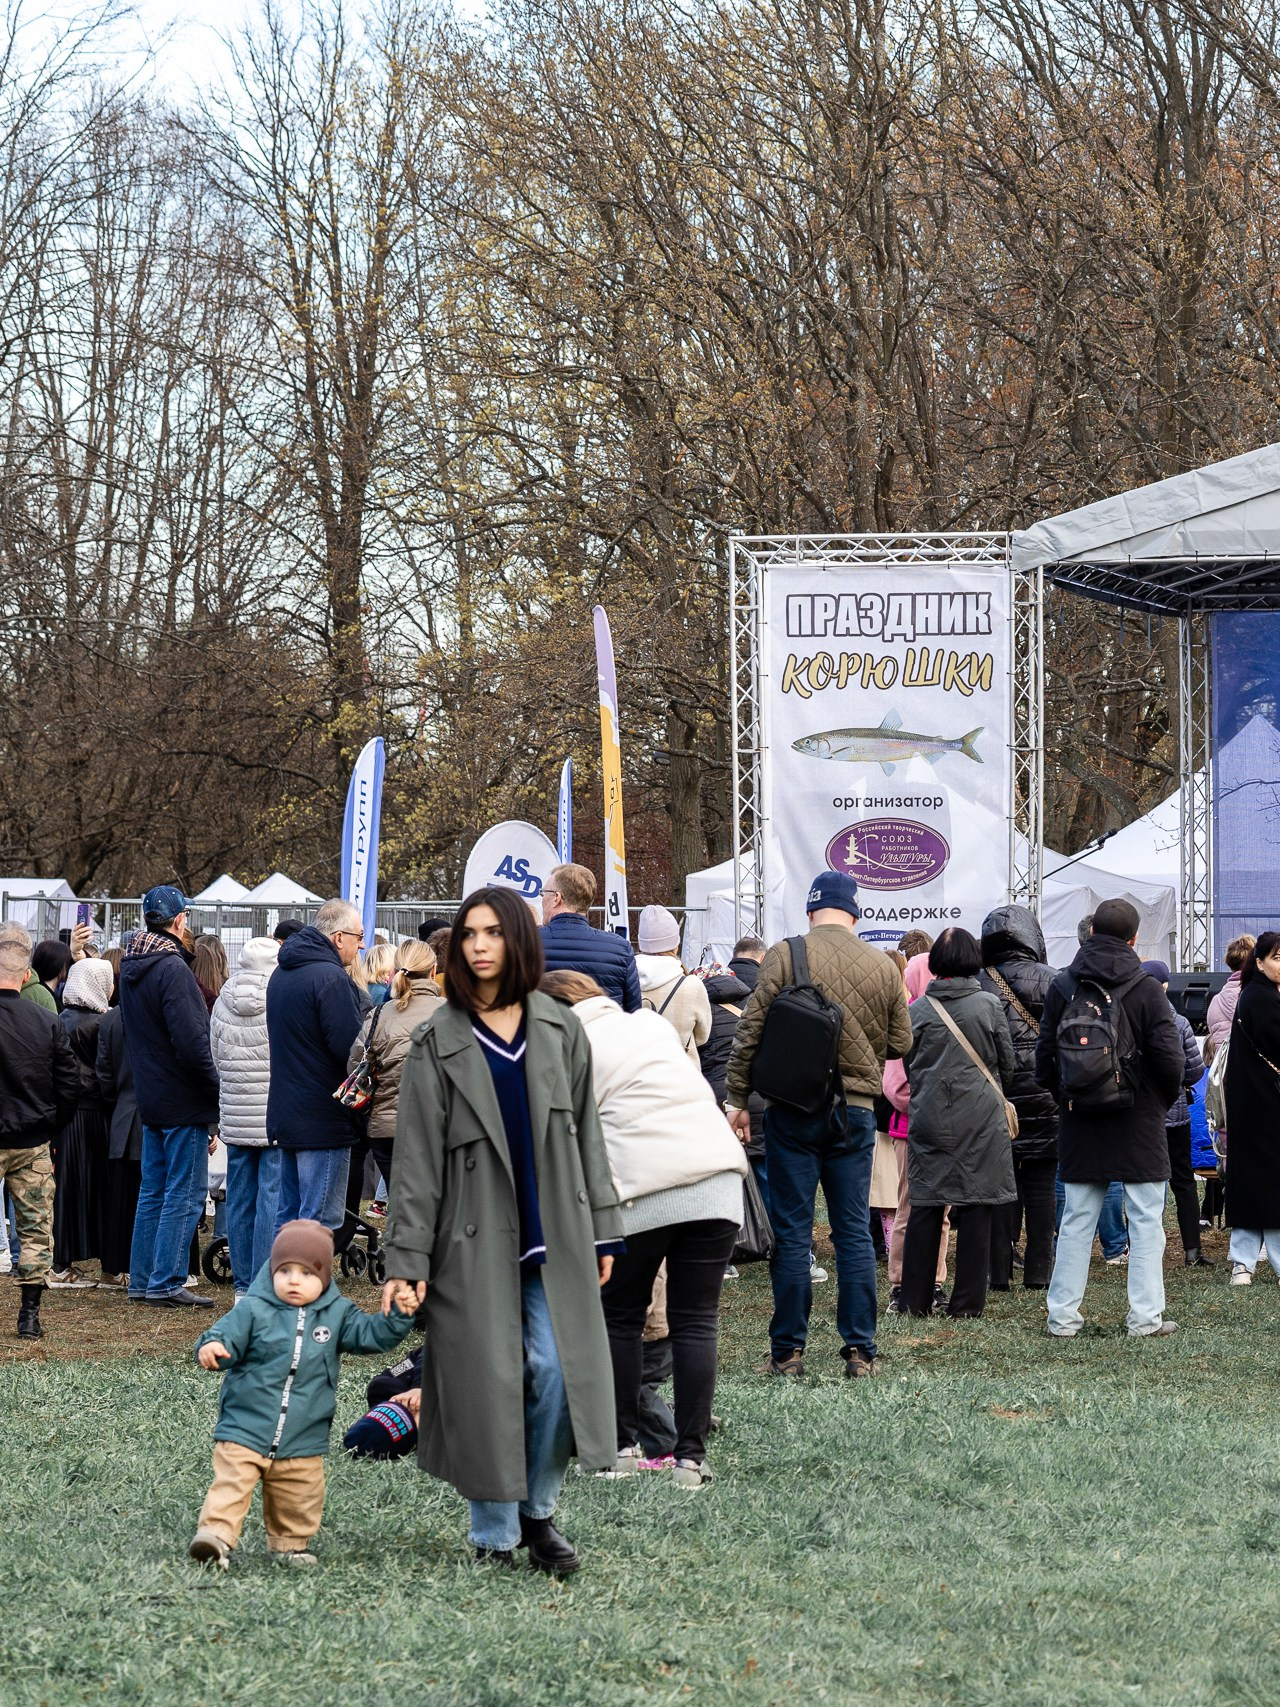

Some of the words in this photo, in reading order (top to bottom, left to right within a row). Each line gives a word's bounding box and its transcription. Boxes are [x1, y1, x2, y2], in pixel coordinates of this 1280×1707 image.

[786, 591, 993, 643] ПРАЗДНИК
[781, 647, 995, 699] КОРЮШКИ
[832, 796, 944, 811] организатор
[857, 823, 892, 834] Российский
[892, 825, 925, 837] творческий
[881, 835, 912, 843] СОЮЗ
[493, 854, 543, 898] ASD
[848, 869, 901, 885] Санкт-Петербургское
[901, 870, 928, 883] отделение
[860, 932, 904, 940] Санкт-Петерб
